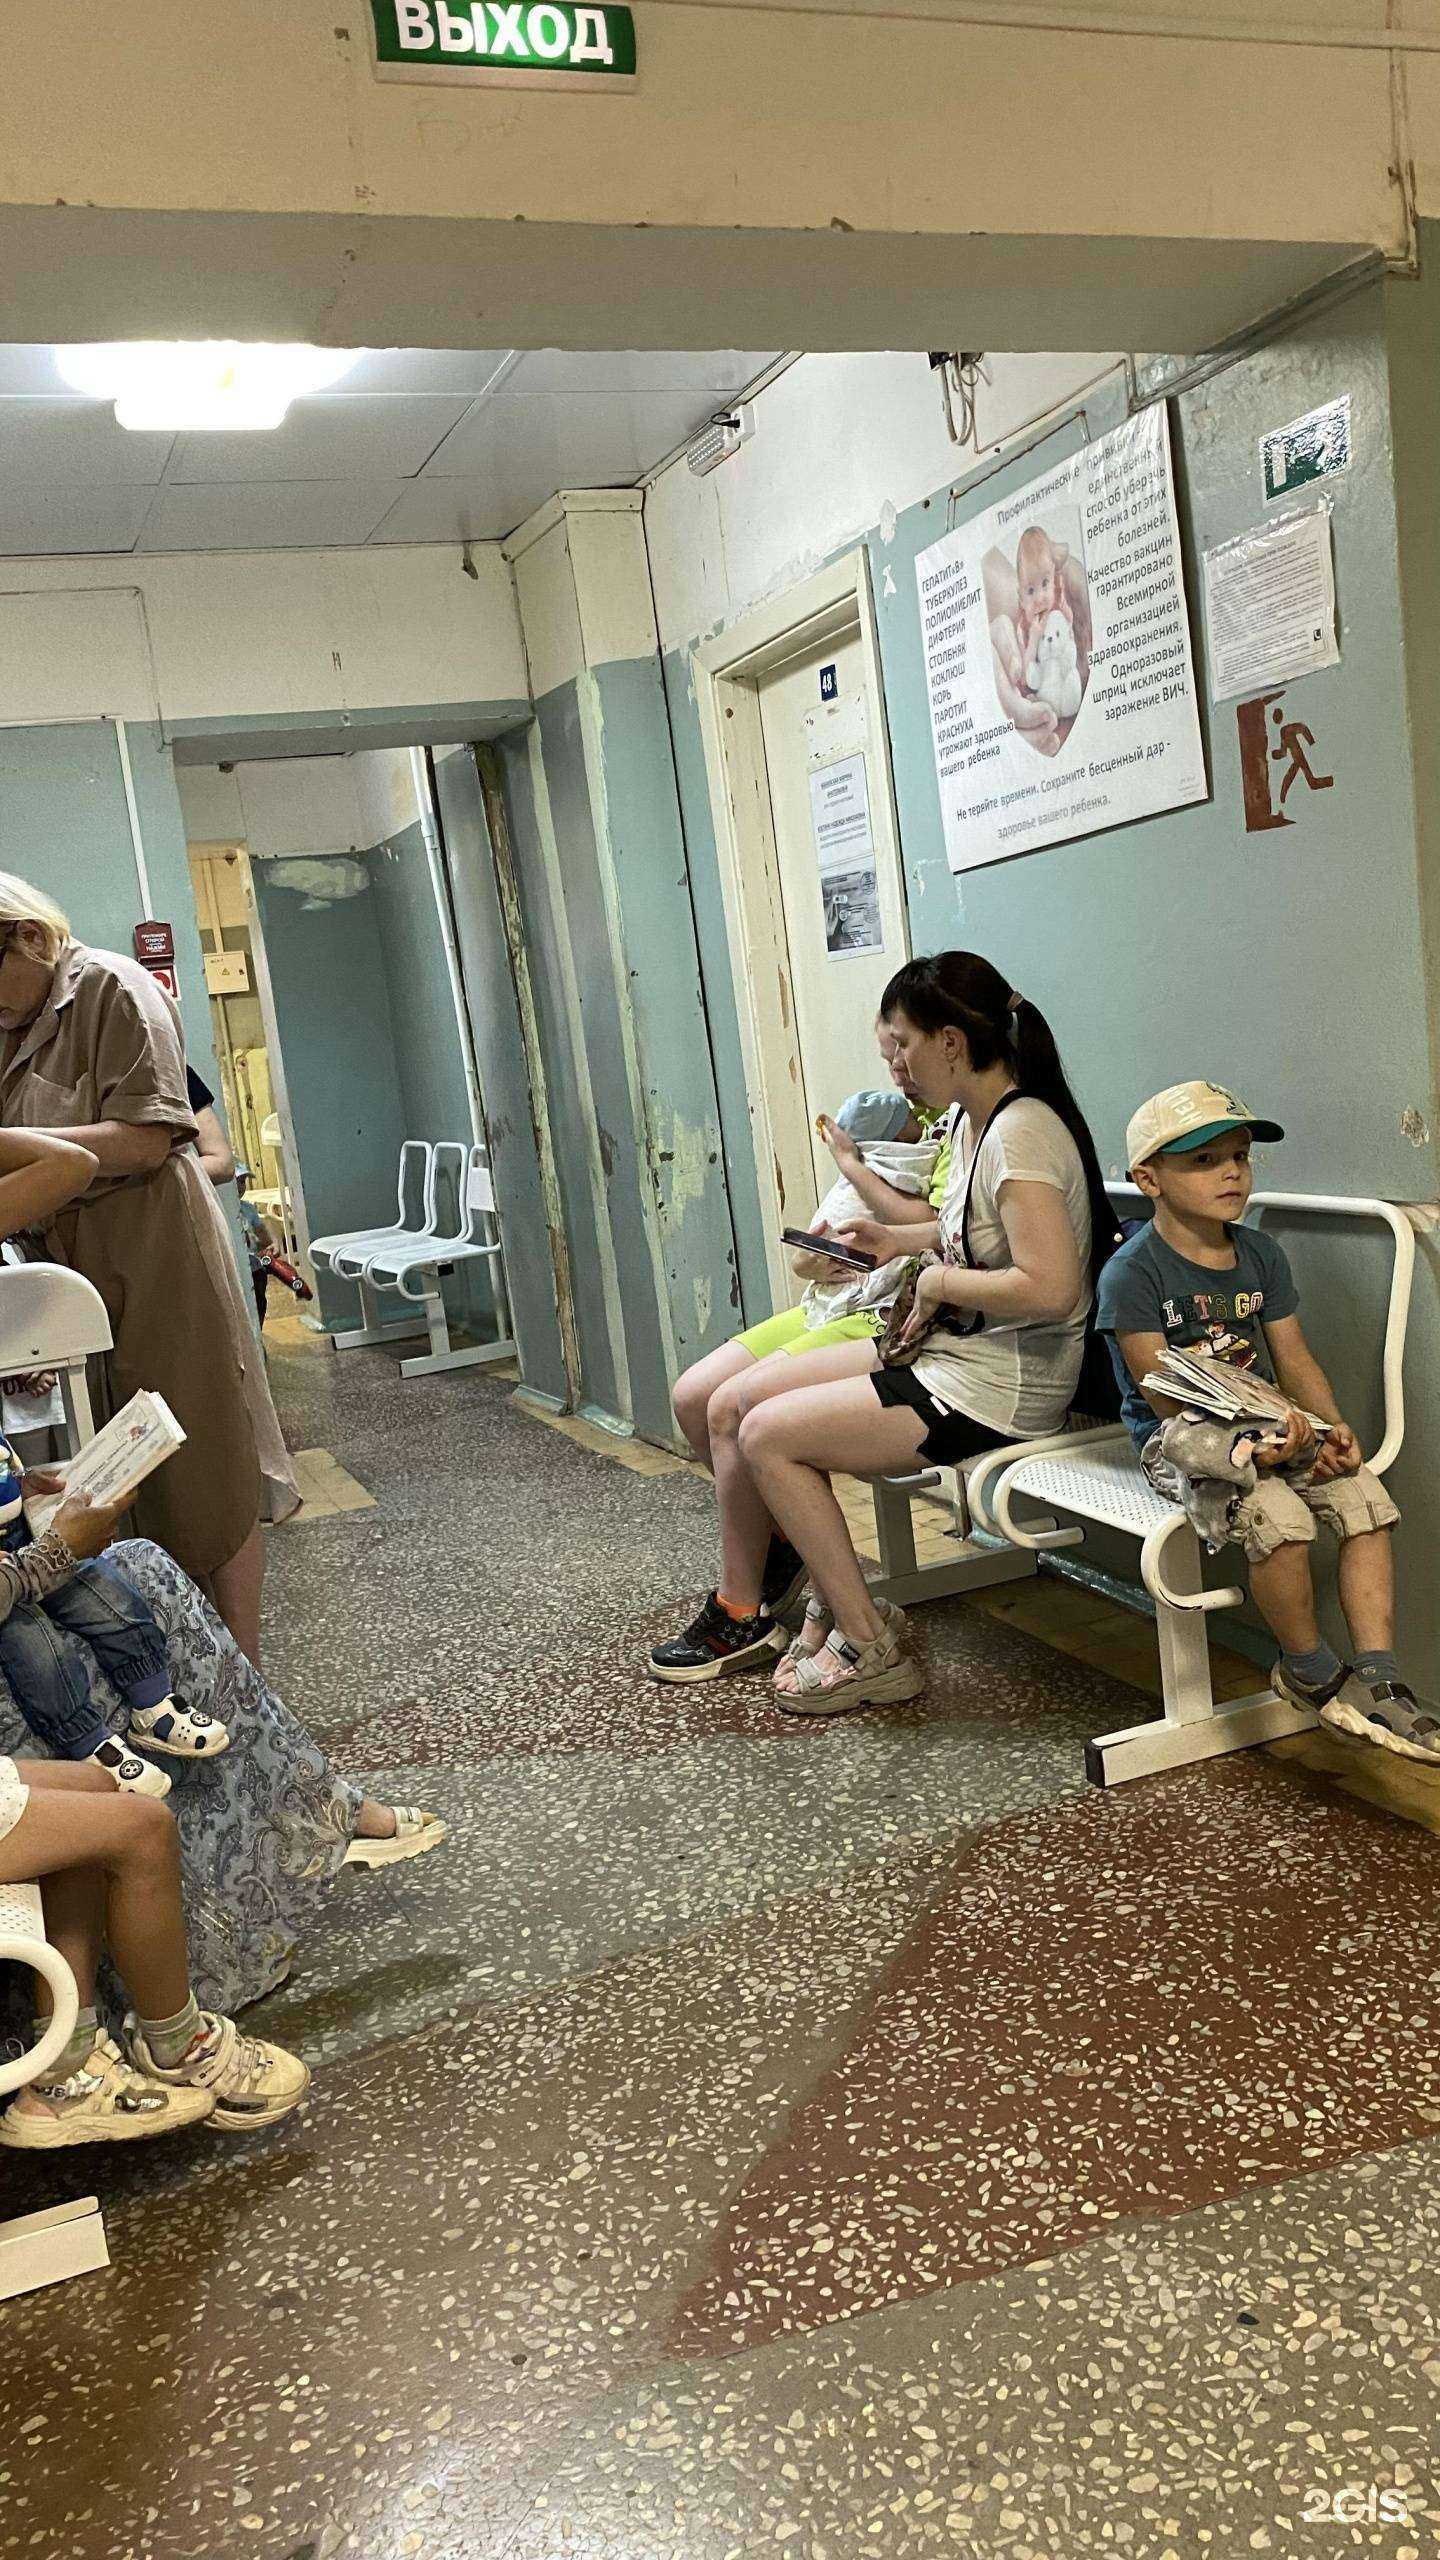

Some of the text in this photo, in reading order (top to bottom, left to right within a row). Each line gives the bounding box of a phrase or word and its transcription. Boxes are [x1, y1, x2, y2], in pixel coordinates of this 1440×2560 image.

[395, 0, 614, 65] ВЫХОД
[1087, 438, 1164, 495] единственнй
[1086, 467, 1167, 519] способ уберечь
[1087, 486, 1167, 541] ребенка от этих
[1117, 508, 1171, 547] болезней.
[1087, 533, 1173, 584] Качество вакцин
[1096, 553, 1174, 598] гарантировано
[924, 576, 969, 611] ТУБЕРКУЛЕЗ
[925, 588, 983, 632] ПОЛИОМИЕЛИТ
[1116, 572, 1176, 611] Всемирной
[928, 618, 967, 652] ДИФТЕРИЯ
[1106, 594, 1180, 639] организацией
[928, 641, 967, 670] СТОЛБНЯК
[1088, 620, 1183, 667] здравоохранения.
[1110, 640, 1184, 680] Одноразовый
[822, 673, 833, 693] 48
[930, 660, 967, 689] КОКЛЮШ
[1092, 662, 1187, 705] шприц исключает
[932, 688, 952, 706] КОРЬ
[934, 700, 968, 726] ПАРОТИТ
[1104, 681, 1189, 722] заражение ВИЧ.
[937, 717, 975, 744] КРАСНУХА
[938, 720, 1015, 761] угрожают здоровью
[939, 745, 1001, 779] вашего ребенка
[956, 807, 968, 822] Не
[968, 797, 999, 819] теряйте
[1000, 785, 1040, 811] времени.
[1040, 768, 1087, 795] Сохраните
[1088, 746, 1144, 778] бесценный
[1146, 742, 1165, 762] дар
[998, 794, 1111, 840] здоровье вашего ребенка.
[1162, 1292, 1228, 1328] LET'S
